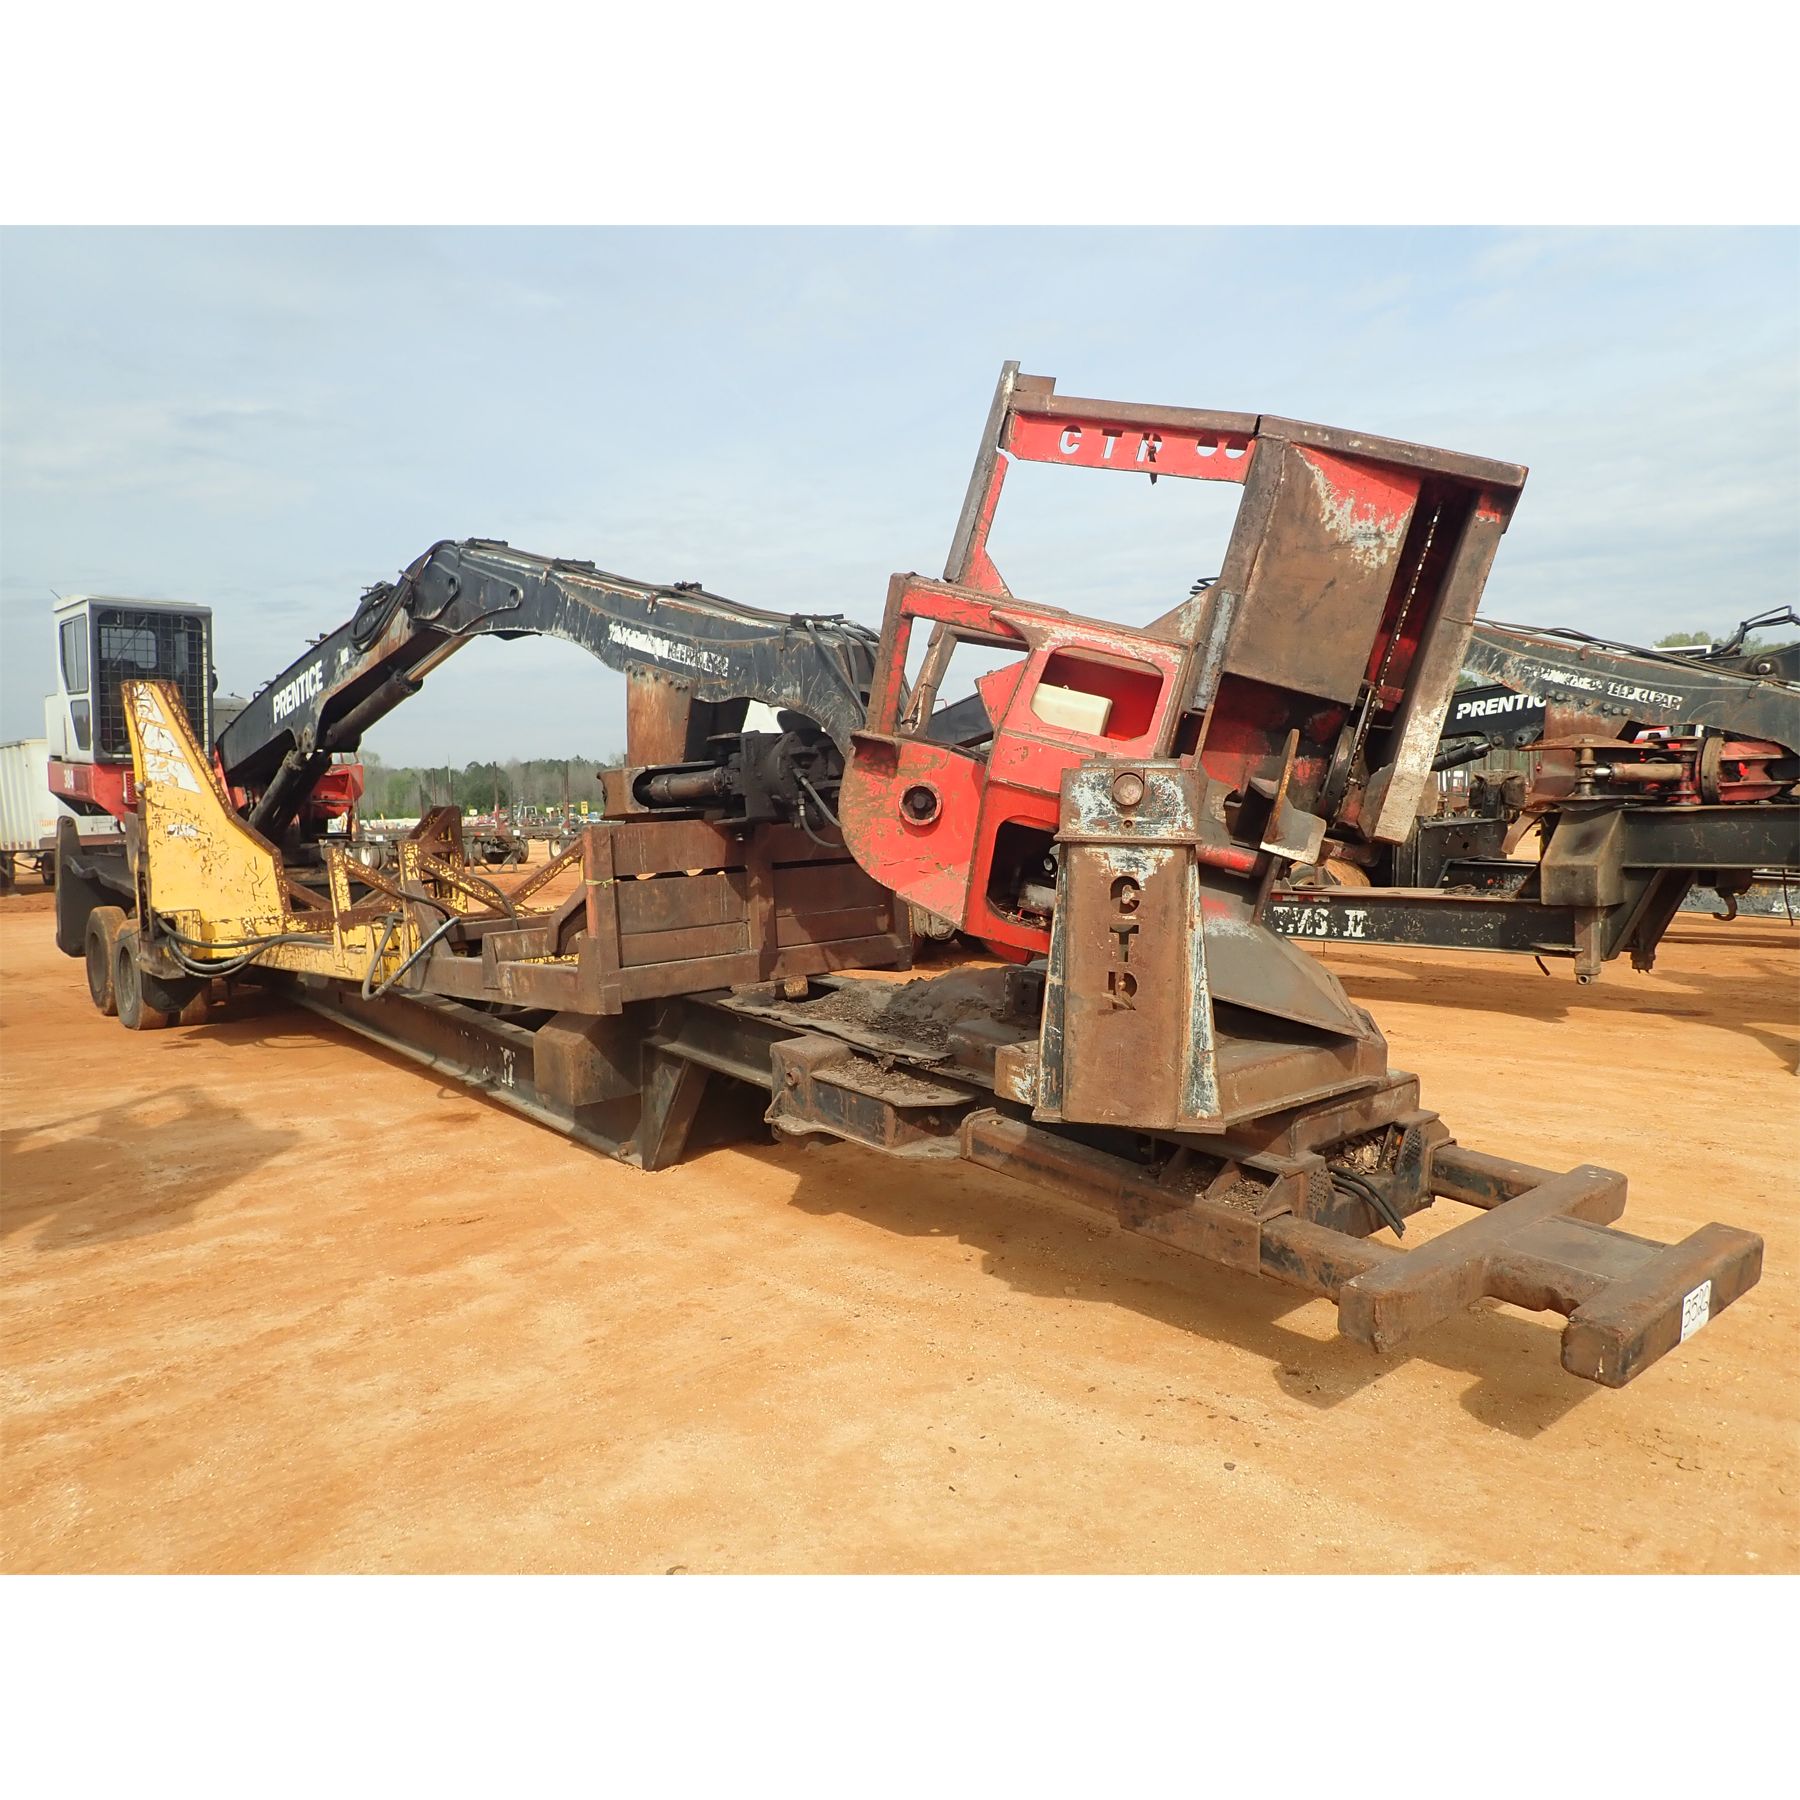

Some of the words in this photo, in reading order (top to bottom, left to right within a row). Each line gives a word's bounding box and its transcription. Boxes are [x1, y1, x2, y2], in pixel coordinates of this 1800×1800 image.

[1058, 425, 1163, 463] CTR
[273, 659, 323, 724] PRENTICE
[1456, 693, 1546, 720] PRENTIC
[1108, 875, 1141, 1012] CTR
